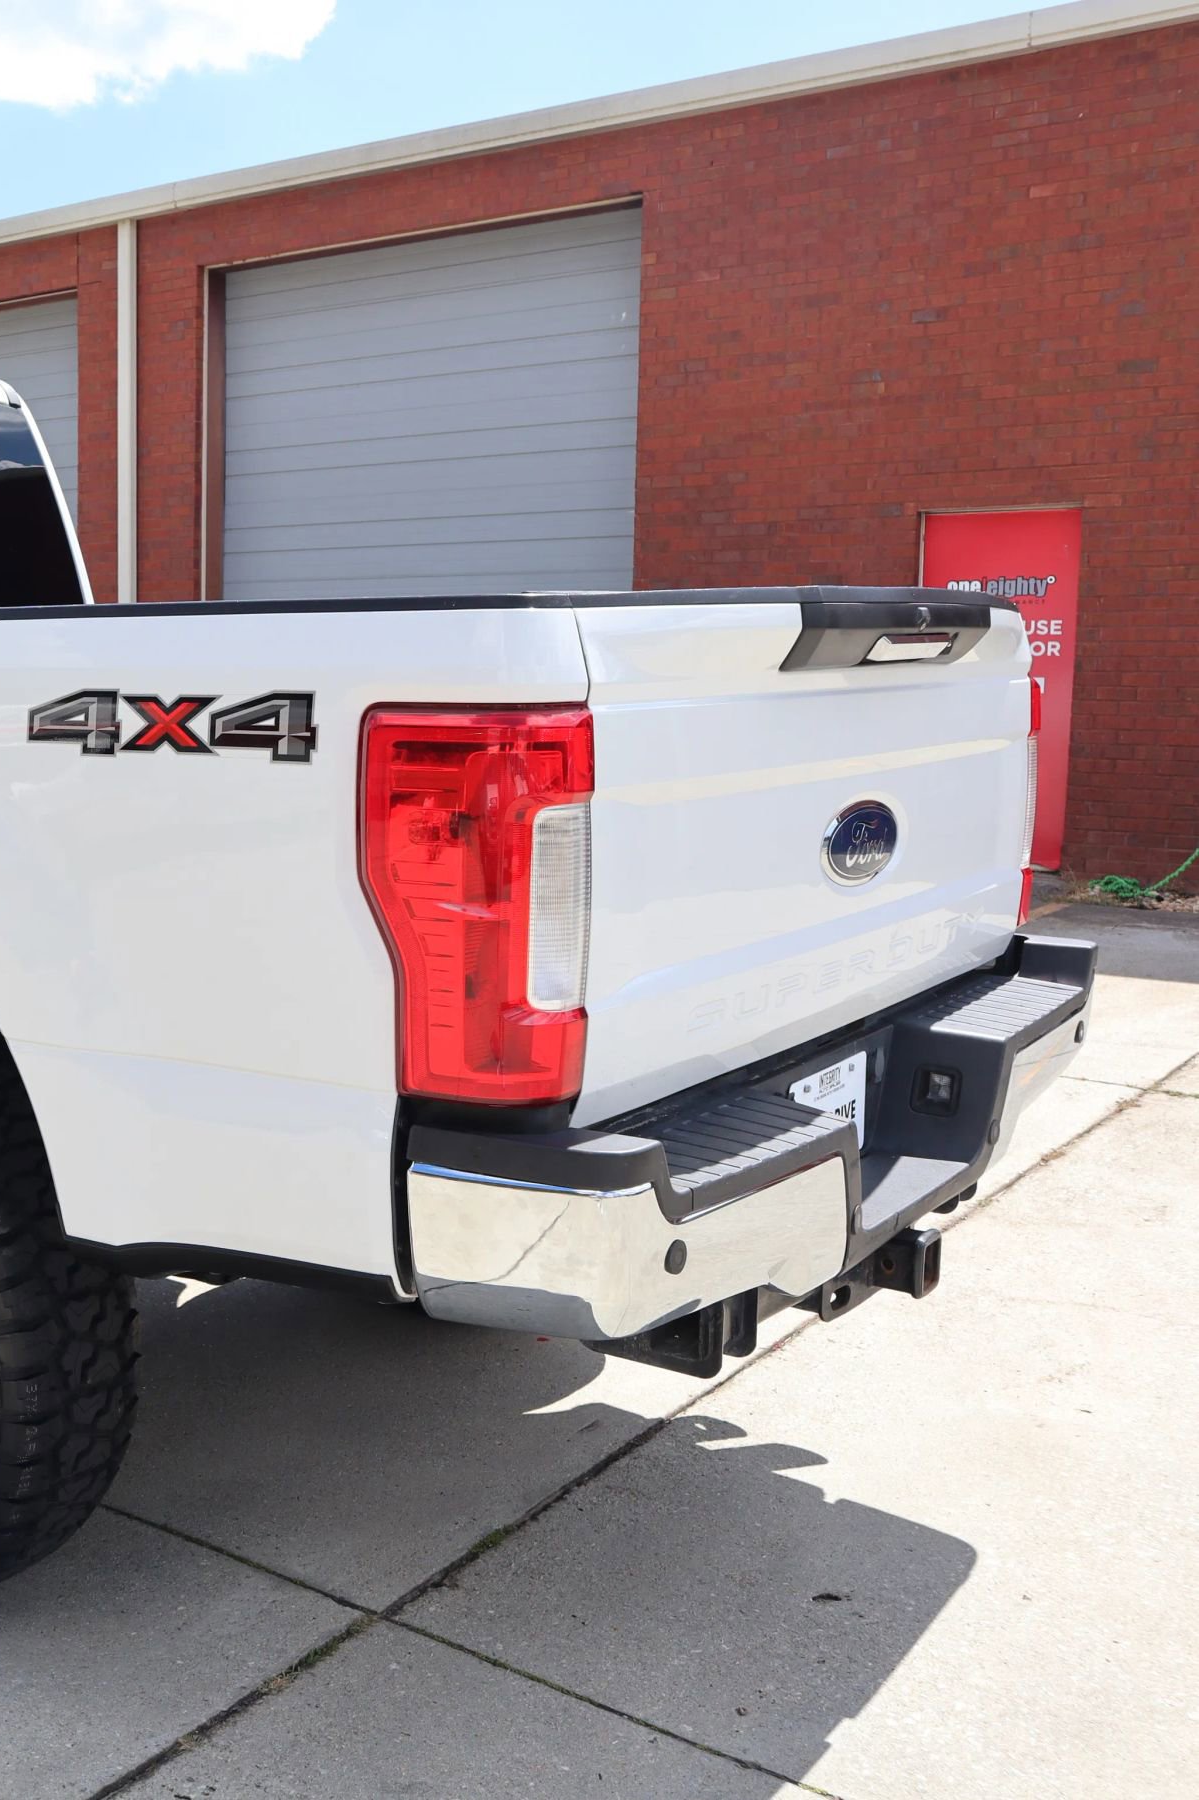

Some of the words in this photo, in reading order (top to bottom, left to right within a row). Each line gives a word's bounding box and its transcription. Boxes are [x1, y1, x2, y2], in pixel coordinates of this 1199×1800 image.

[26, 688, 319, 765] 4X4
[846, 819, 888, 868] Ford
[686, 947, 876, 1034] SUPER
[887, 905, 985, 967] DUTY
